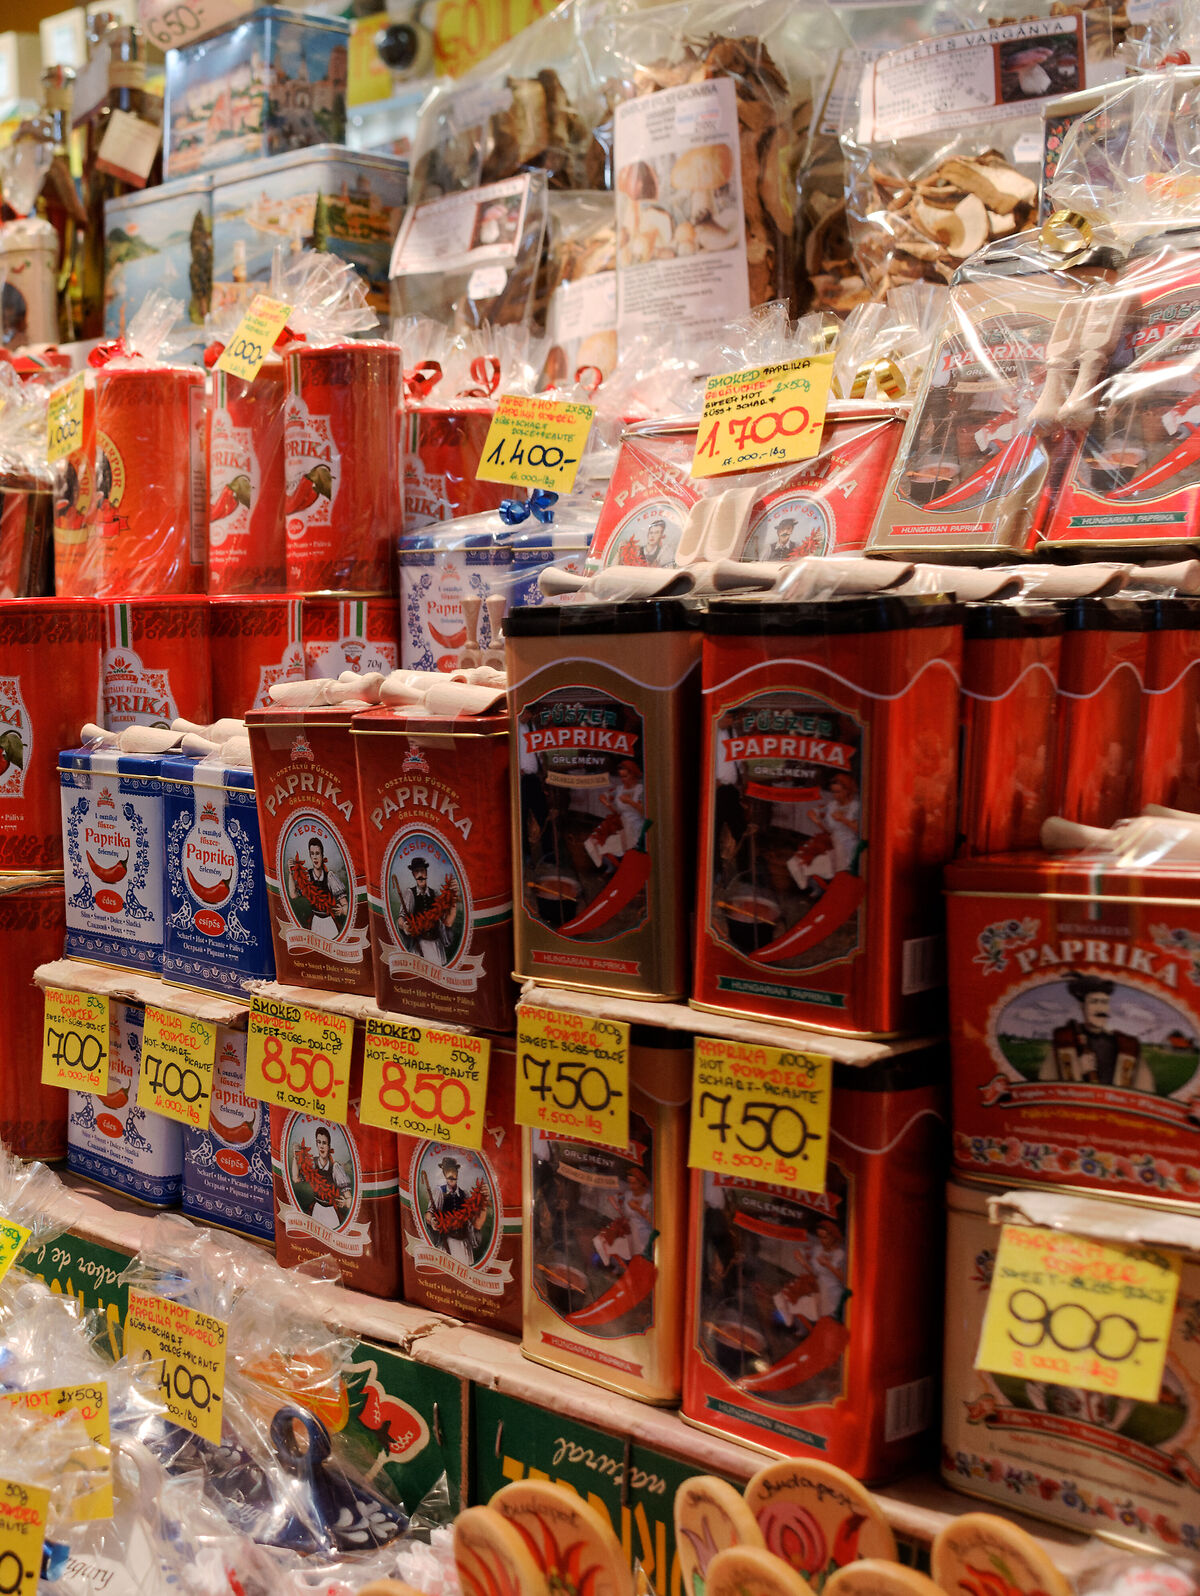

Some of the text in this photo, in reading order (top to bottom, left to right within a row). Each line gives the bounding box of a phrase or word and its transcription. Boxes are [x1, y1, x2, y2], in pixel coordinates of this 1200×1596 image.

[707, 369, 760, 390] SMOKED
[901, 524, 984, 535] HUNGARIAN PAPRIKA
[1081, 513, 1176, 527] HUNGARIAN PAPRIKA
[367, 658, 383, 670] 70g
[105, 695, 171, 719] PRIKA
[530, 727, 631, 752] PAPRIKA
[729, 738, 846, 766] PAPRIKA
[264, 771, 355, 823] PAPRIKA
[368, 785, 474, 842] PAPRIKA
[85, 827, 132, 849] Paprika
[186, 843, 236, 867] Paprika
[543, 954, 628, 972] HUNGARIAN PAPRIKA
[1015, 938, 1178, 989] PAPRIKA
[732, 981, 788, 997] HUNGARIAN
[251, 999, 348, 1034] SMOKED PAPRIKA
[189, 1021, 213, 1046] 50g
[321, 1029, 344, 1050] 50g
[366, 1019, 482, 1054] SMOKED PAPRIKA
[450, 1051, 477, 1071] 50g
[699, 1057, 724, 1073] HOT
[50, 1247, 72, 1272] de
[552, 1436, 667, 1495] natural
[4, 1482, 29, 1506] 50g
